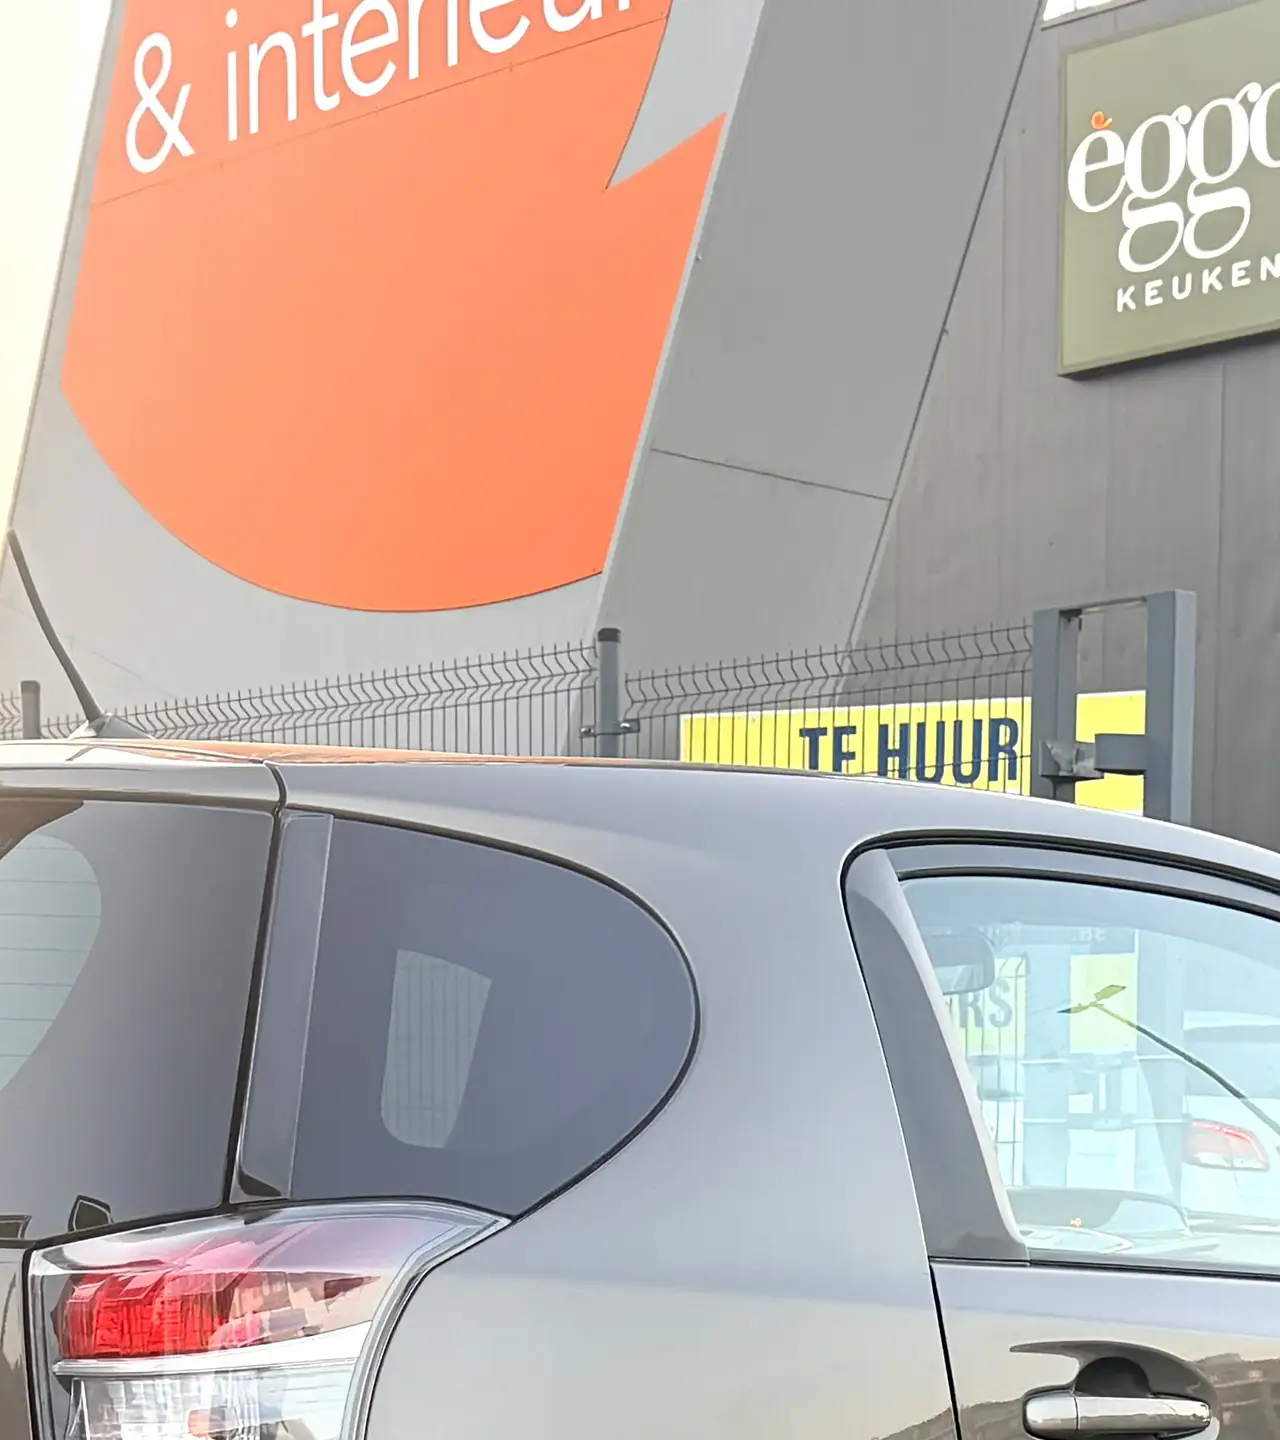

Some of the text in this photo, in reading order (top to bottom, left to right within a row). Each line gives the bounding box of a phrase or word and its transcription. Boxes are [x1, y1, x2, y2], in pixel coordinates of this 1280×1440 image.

[125, 32, 196, 174] &
[799, 717, 1019, 784] TE HUUR
